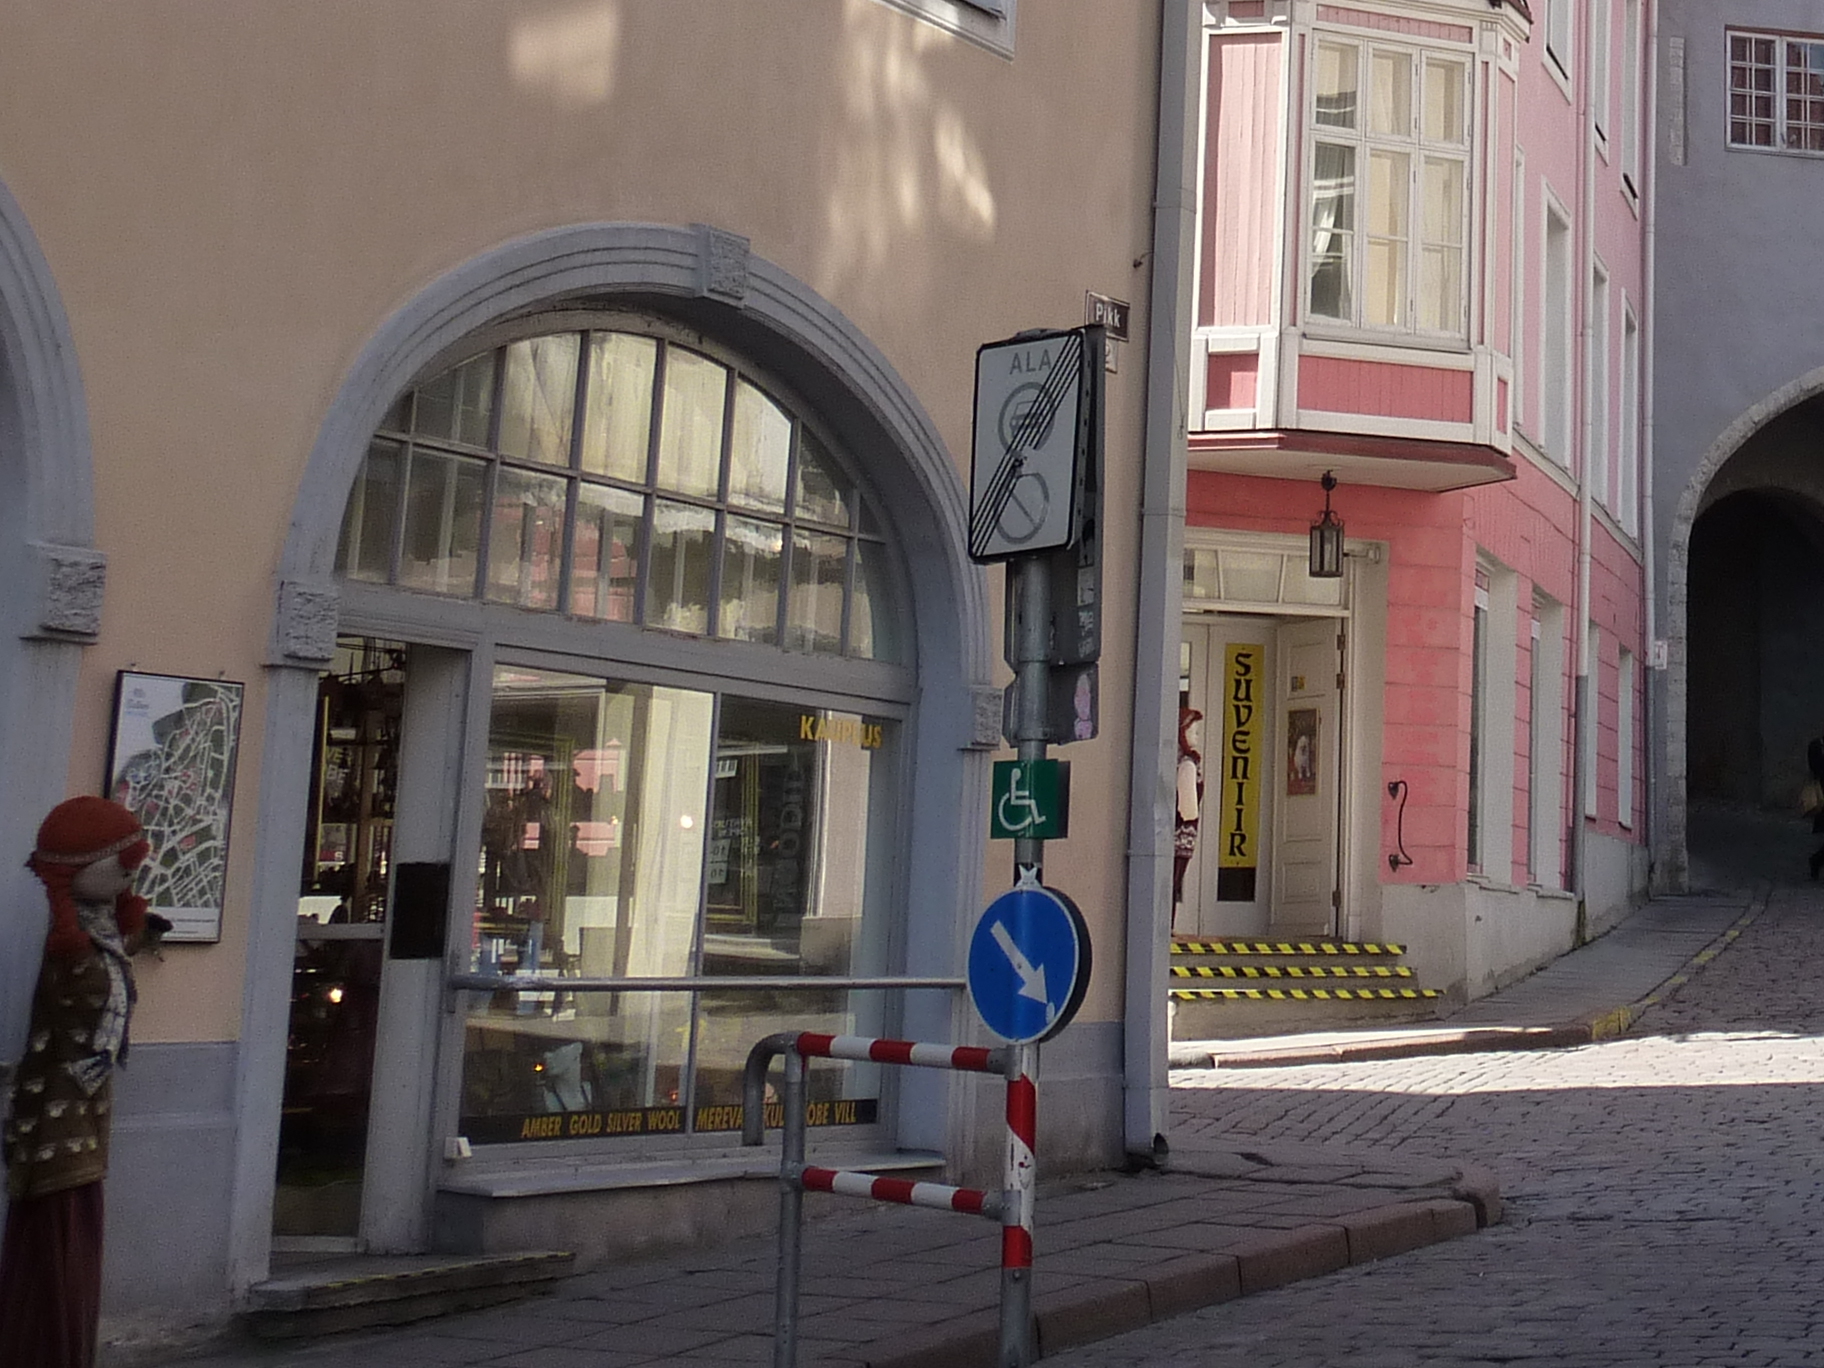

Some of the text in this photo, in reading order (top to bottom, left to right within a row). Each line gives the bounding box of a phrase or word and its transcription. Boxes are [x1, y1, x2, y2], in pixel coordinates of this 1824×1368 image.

[1096, 302, 1121, 328] Pikk
[1009, 348, 1052, 375] ALA
[800, 715, 883, 749] KAUPLUS
[1228, 652, 1253, 857] SUVENIIR
[521, 1109, 681, 1138] AMBER GOLD SILVER WOOL
[695, 1106, 744, 1131] MEREVA
[834, 1101, 857, 1124] VILL
